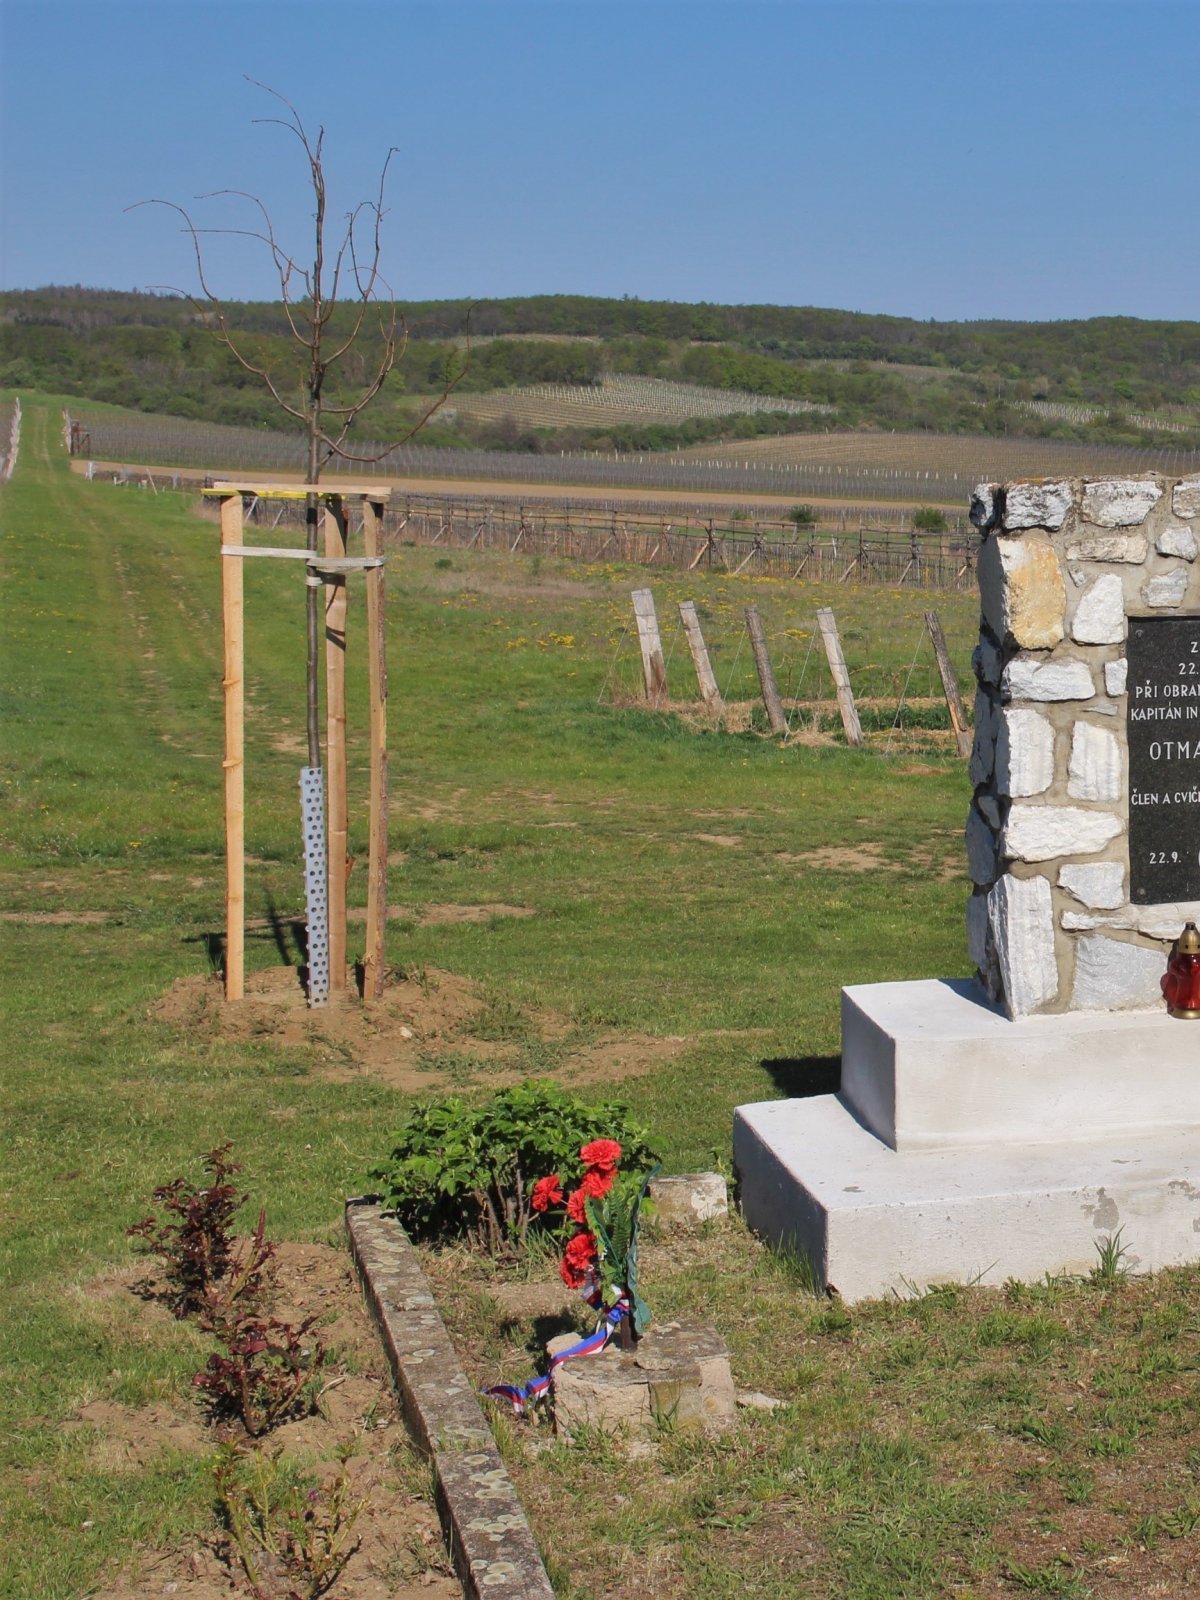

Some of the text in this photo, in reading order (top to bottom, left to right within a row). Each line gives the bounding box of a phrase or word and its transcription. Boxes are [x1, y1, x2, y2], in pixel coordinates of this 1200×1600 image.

[1178, 663, 1199, 675] 22.
[1135, 680, 1158, 699] PŘI
[1131, 702, 1182, 721] KAPITÁN
[1186, 707, 1198, 719] IN
[1131, 788, 1159, 806] ČLEN
[1163, 792, 1171, 804] A
